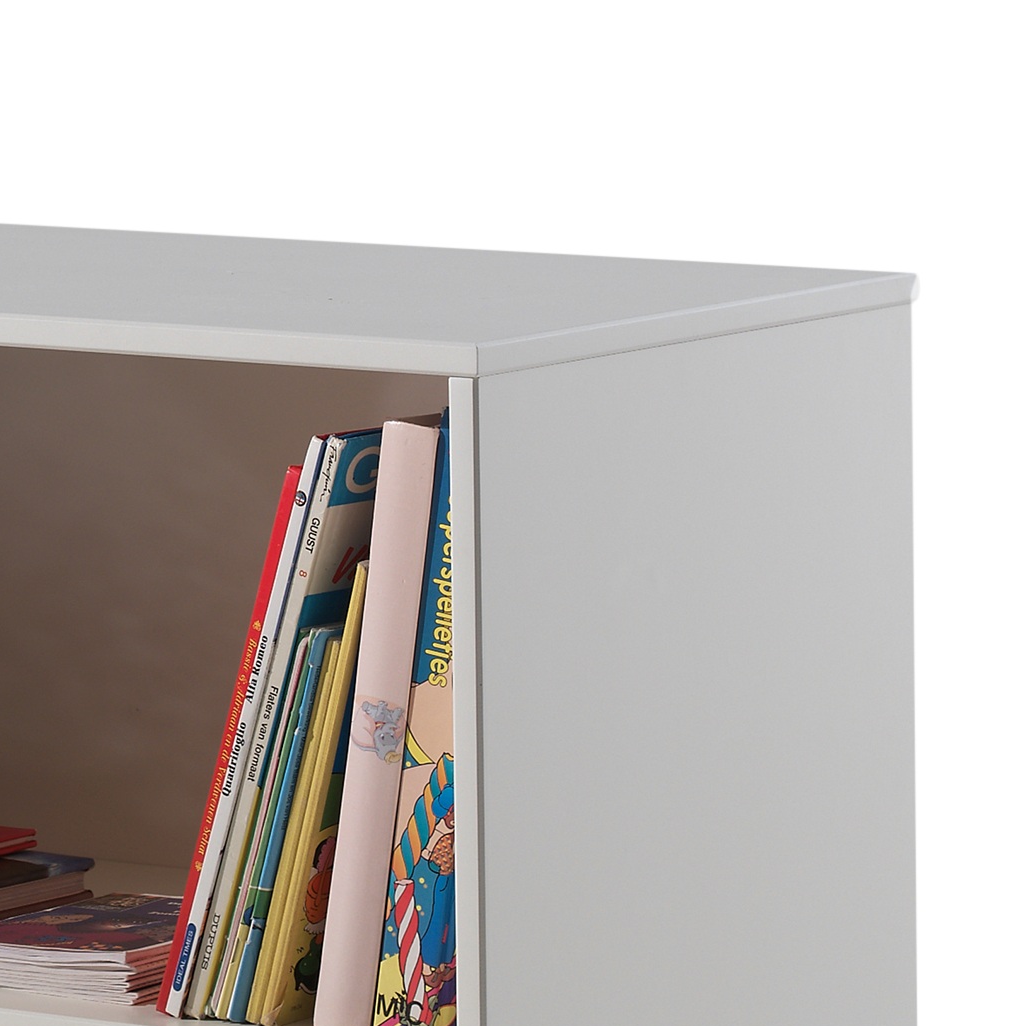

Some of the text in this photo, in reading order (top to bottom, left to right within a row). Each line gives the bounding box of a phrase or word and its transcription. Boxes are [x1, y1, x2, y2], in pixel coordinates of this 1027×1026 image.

[304, 517, 322, 554] GUUST
[299, 569, 308, 578] 8
[220, 635, 270, 798] Quadrifoglio Alfa Romeo
[247, 685, 280, 782] Flaters van formaat
[174, 930, 194, 985] IDEAL TIMES
[201, 913, 222, 971] DUPUIS
